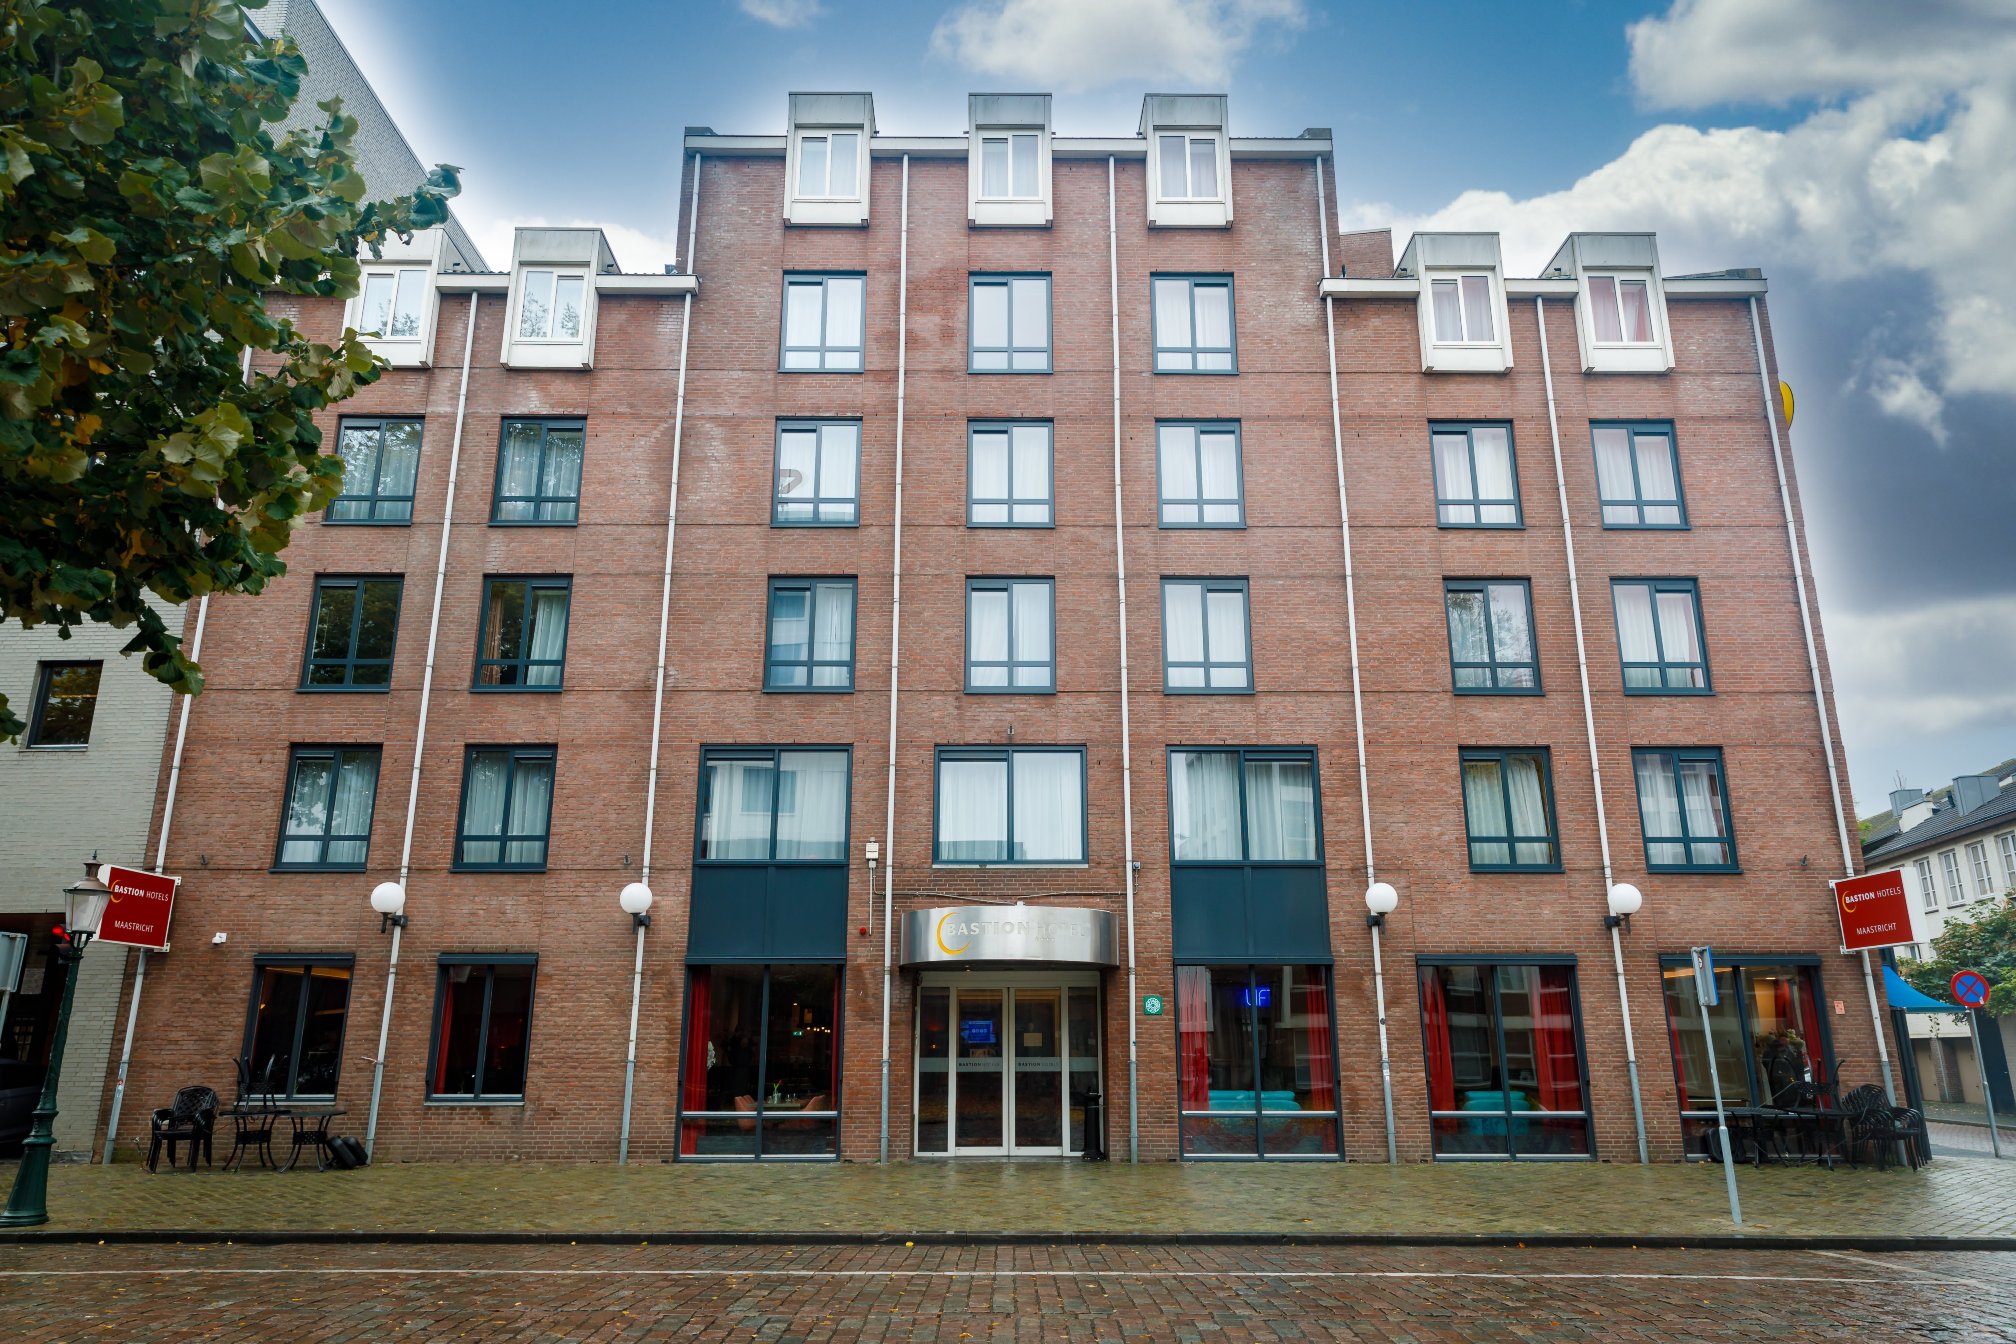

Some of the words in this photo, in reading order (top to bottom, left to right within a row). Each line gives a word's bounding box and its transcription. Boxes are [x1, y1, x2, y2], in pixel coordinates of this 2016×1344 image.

[114, 884, 145, 897] BASTION
[146, 891, 169, 902] HOTELS
[1845, 891, 1875, 904] BASTION
[1876, 886, 1902, 898] HOTELS
[114, 920, 154, 933] MAASTRICHT
[947, 921, 1030, 937] BASTION
[1856, 922, 1897, 935] MAASTRICHT
